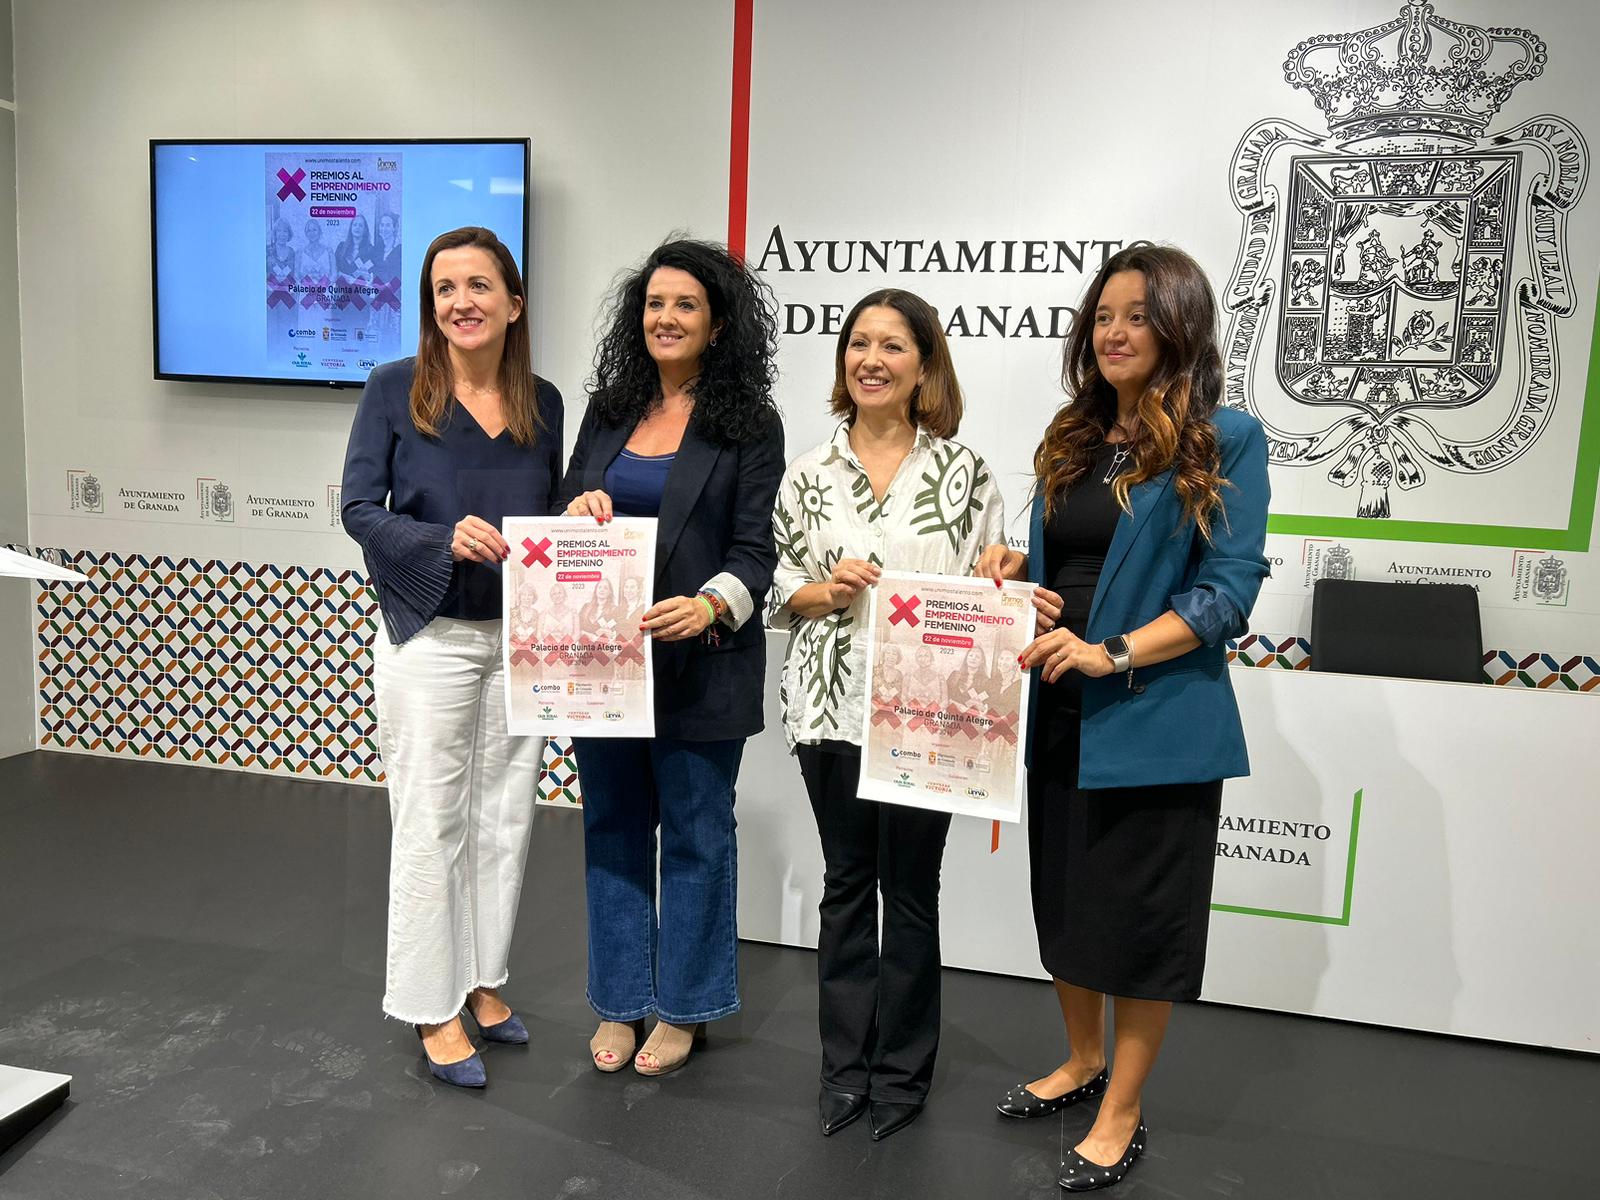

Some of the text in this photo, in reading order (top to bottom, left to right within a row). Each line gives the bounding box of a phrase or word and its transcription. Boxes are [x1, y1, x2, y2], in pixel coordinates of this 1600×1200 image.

[1237, 127, 1288, 200] GRANADA
[1521, 123, 1580, 199] MUY NOBLE
[310, 171, 364, 180] PREMIOS AL
[311, 182, 391, 191] EMPRENDIMIENTO
[311, 193, 357, 201] FEMENINO
[757, 224, 1157, 274] AYUNTAMIENT
[1233, 212, 1272, 297] CIUDAD DE
[1535, 206, 1565, 299] MUY LEAL
[288, 285, 379, 296] Palacio de Quinta Alegre
[783, 303, 844, 336] DE
[1469, 310, 1552, 465] NOMBRADA GRANDE
[119, 488, 185, 500] AYUNTAMIENTO
[137, 500, 180, 512] GRANADA
[246, 494, 314, 508] AYUNTAMIENTO
[252, 507, 309, 519] DE GRANADA
[557, 540, 610, 548] PREMIOS AL
[557, 549, 637, 558] EMPRENDIMIENTO
[557, 559, 604, 567] FEMENINO
[1304, 544, 1313, 588] AYUNTAMIENTO
[1312, 548, 1320, 577] GRANADA
[1387, 561, 1492, 579] AYUNTAMIENTO
[1512, 555, 1524, 602] AYUNTAMIENTO
[1522, 560, 1532, 598] DE GRANADA
[926, 600, 984, 612] PREMIOS AL
[925, 610, 1014, 626] EMPRENDIMIENTO
[924, 620, 976, 632] FEMENINO
[531, 644, 558, 652] Palacio
[571, 644, 596, 652] Quinta
[597, 644, 622, 652] Alegre
[940, 638, 972, 646] noviembre
[560, 652, 594, 660] GRANADA
[894, 706, 994, 726] Palacio de Quinta Alegre
[900, 750, 922, 758] combo
[1215, 842, 1312, 866] RANADA
